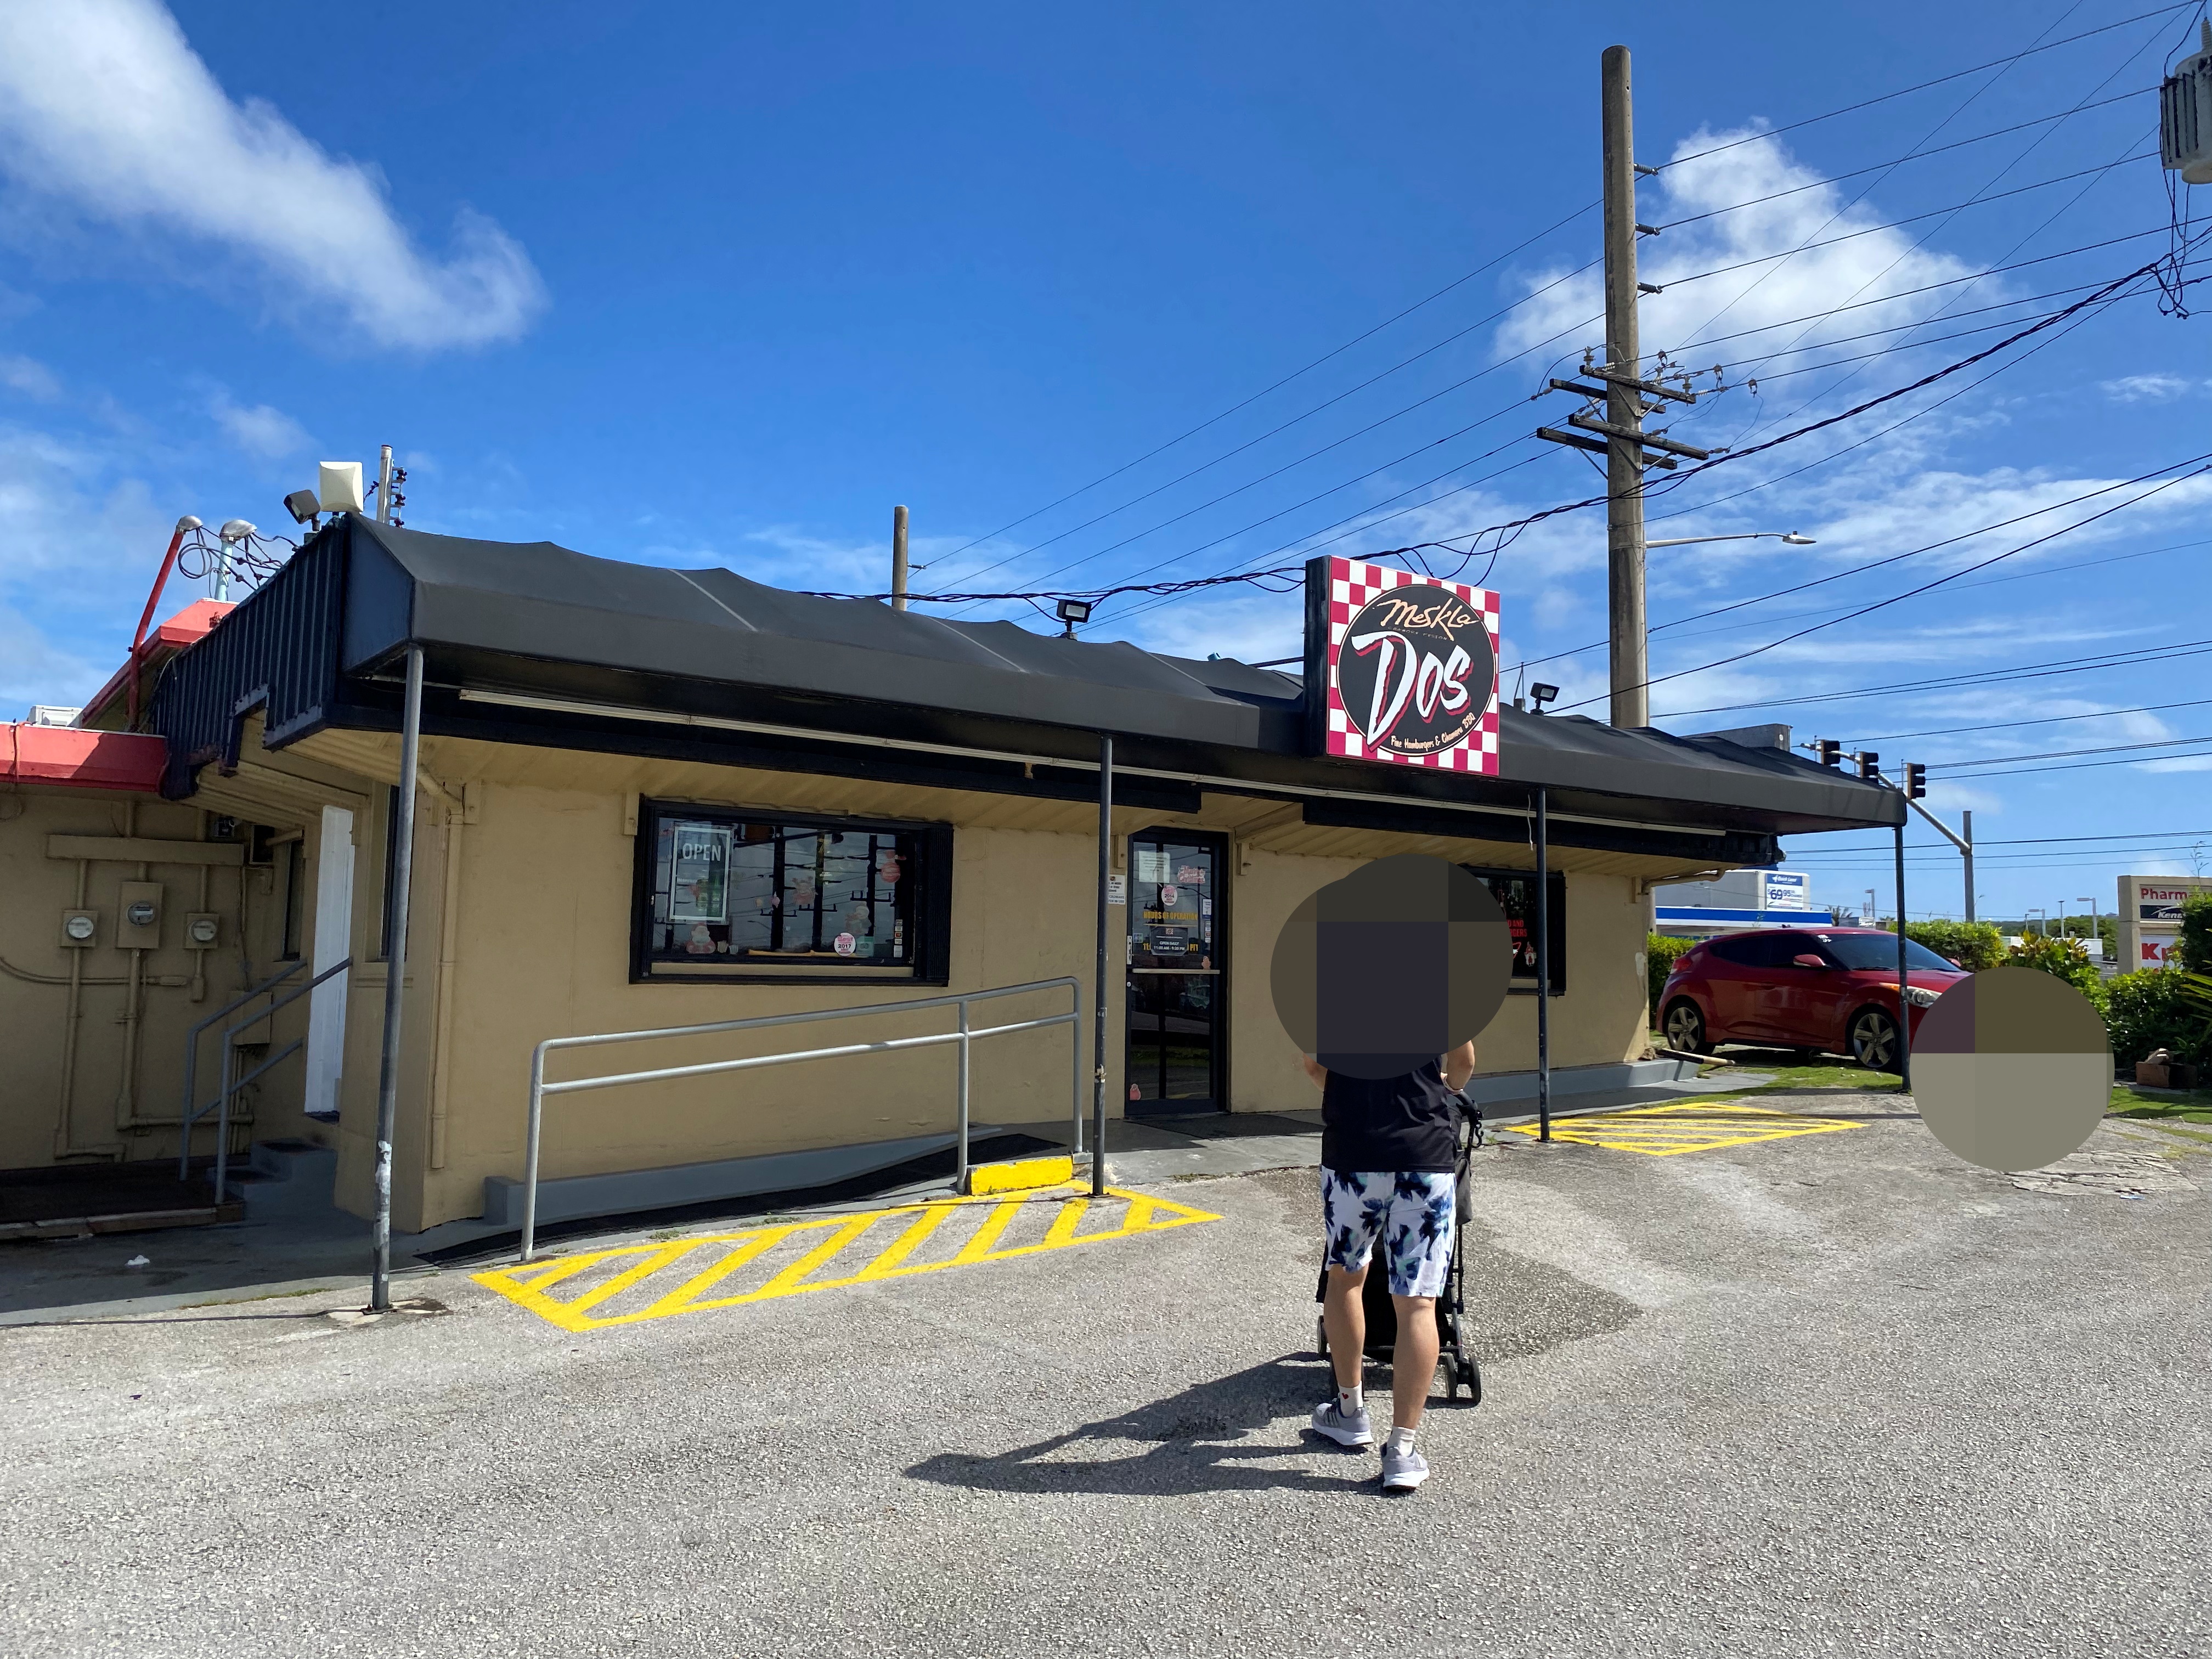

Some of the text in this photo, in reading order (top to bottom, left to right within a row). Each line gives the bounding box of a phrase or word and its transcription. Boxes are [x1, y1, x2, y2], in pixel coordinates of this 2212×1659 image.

[1391, 735, 1402, 748] Fine
[1404, 738, 1435, 752] Hamburgers
[1435, 736, 1441, 746] &
[1462, 712, 1476, 729] BBQ
[682, 843, 721, 861] OPEN
[2141, 888, 2191, 900] Pharm
[1143, 911, 1162, 919] HOURS
[1510, 928, 1527, 937] RGERS
